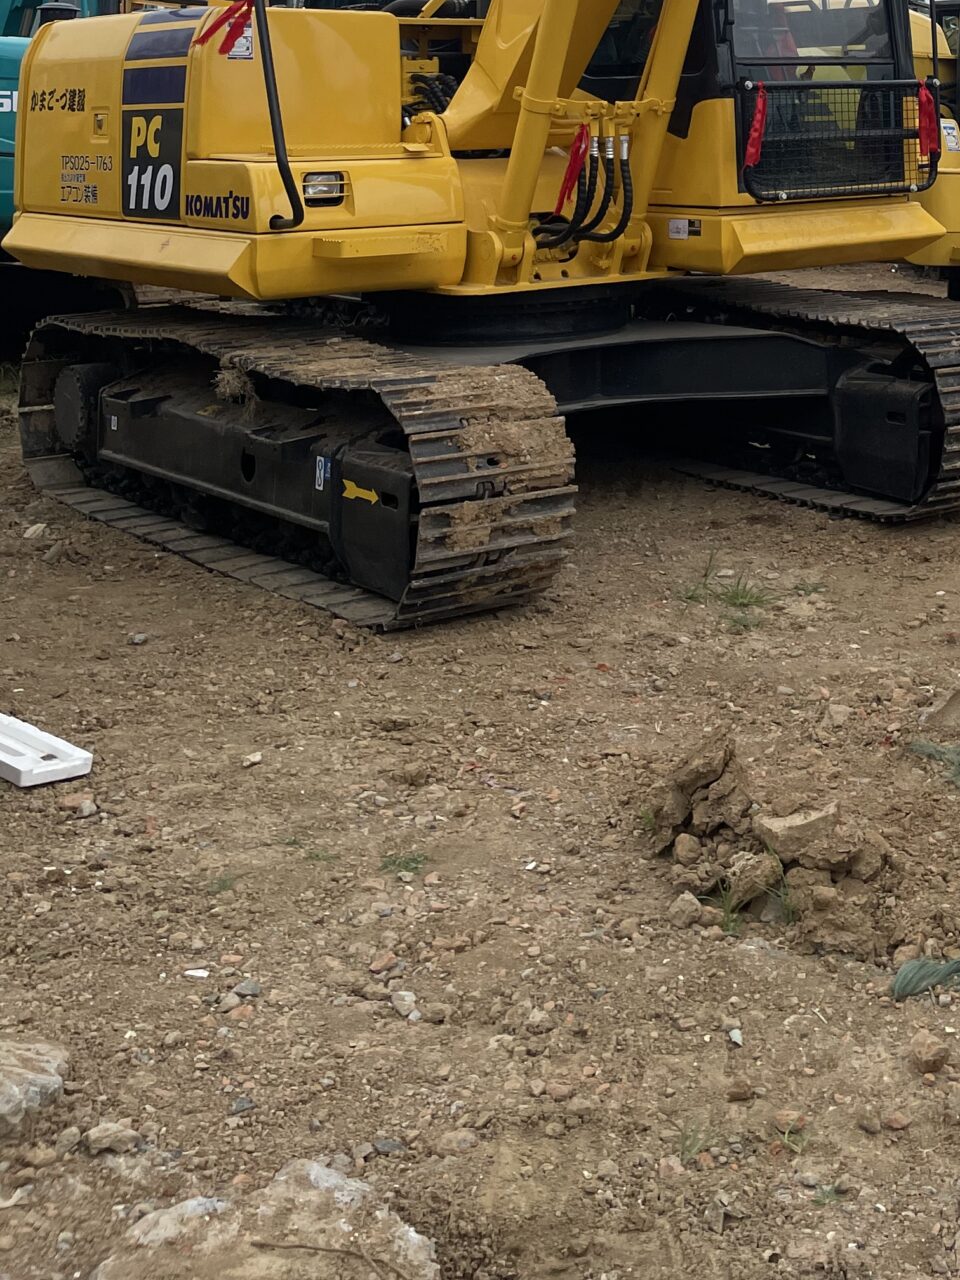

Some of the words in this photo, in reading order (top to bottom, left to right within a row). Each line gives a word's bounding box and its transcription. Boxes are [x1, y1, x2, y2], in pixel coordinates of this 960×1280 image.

[130, 115, 162, 158] PC
[127, 164, 173, 210] 110
[185, 190, 250, 219] KOMATSU
